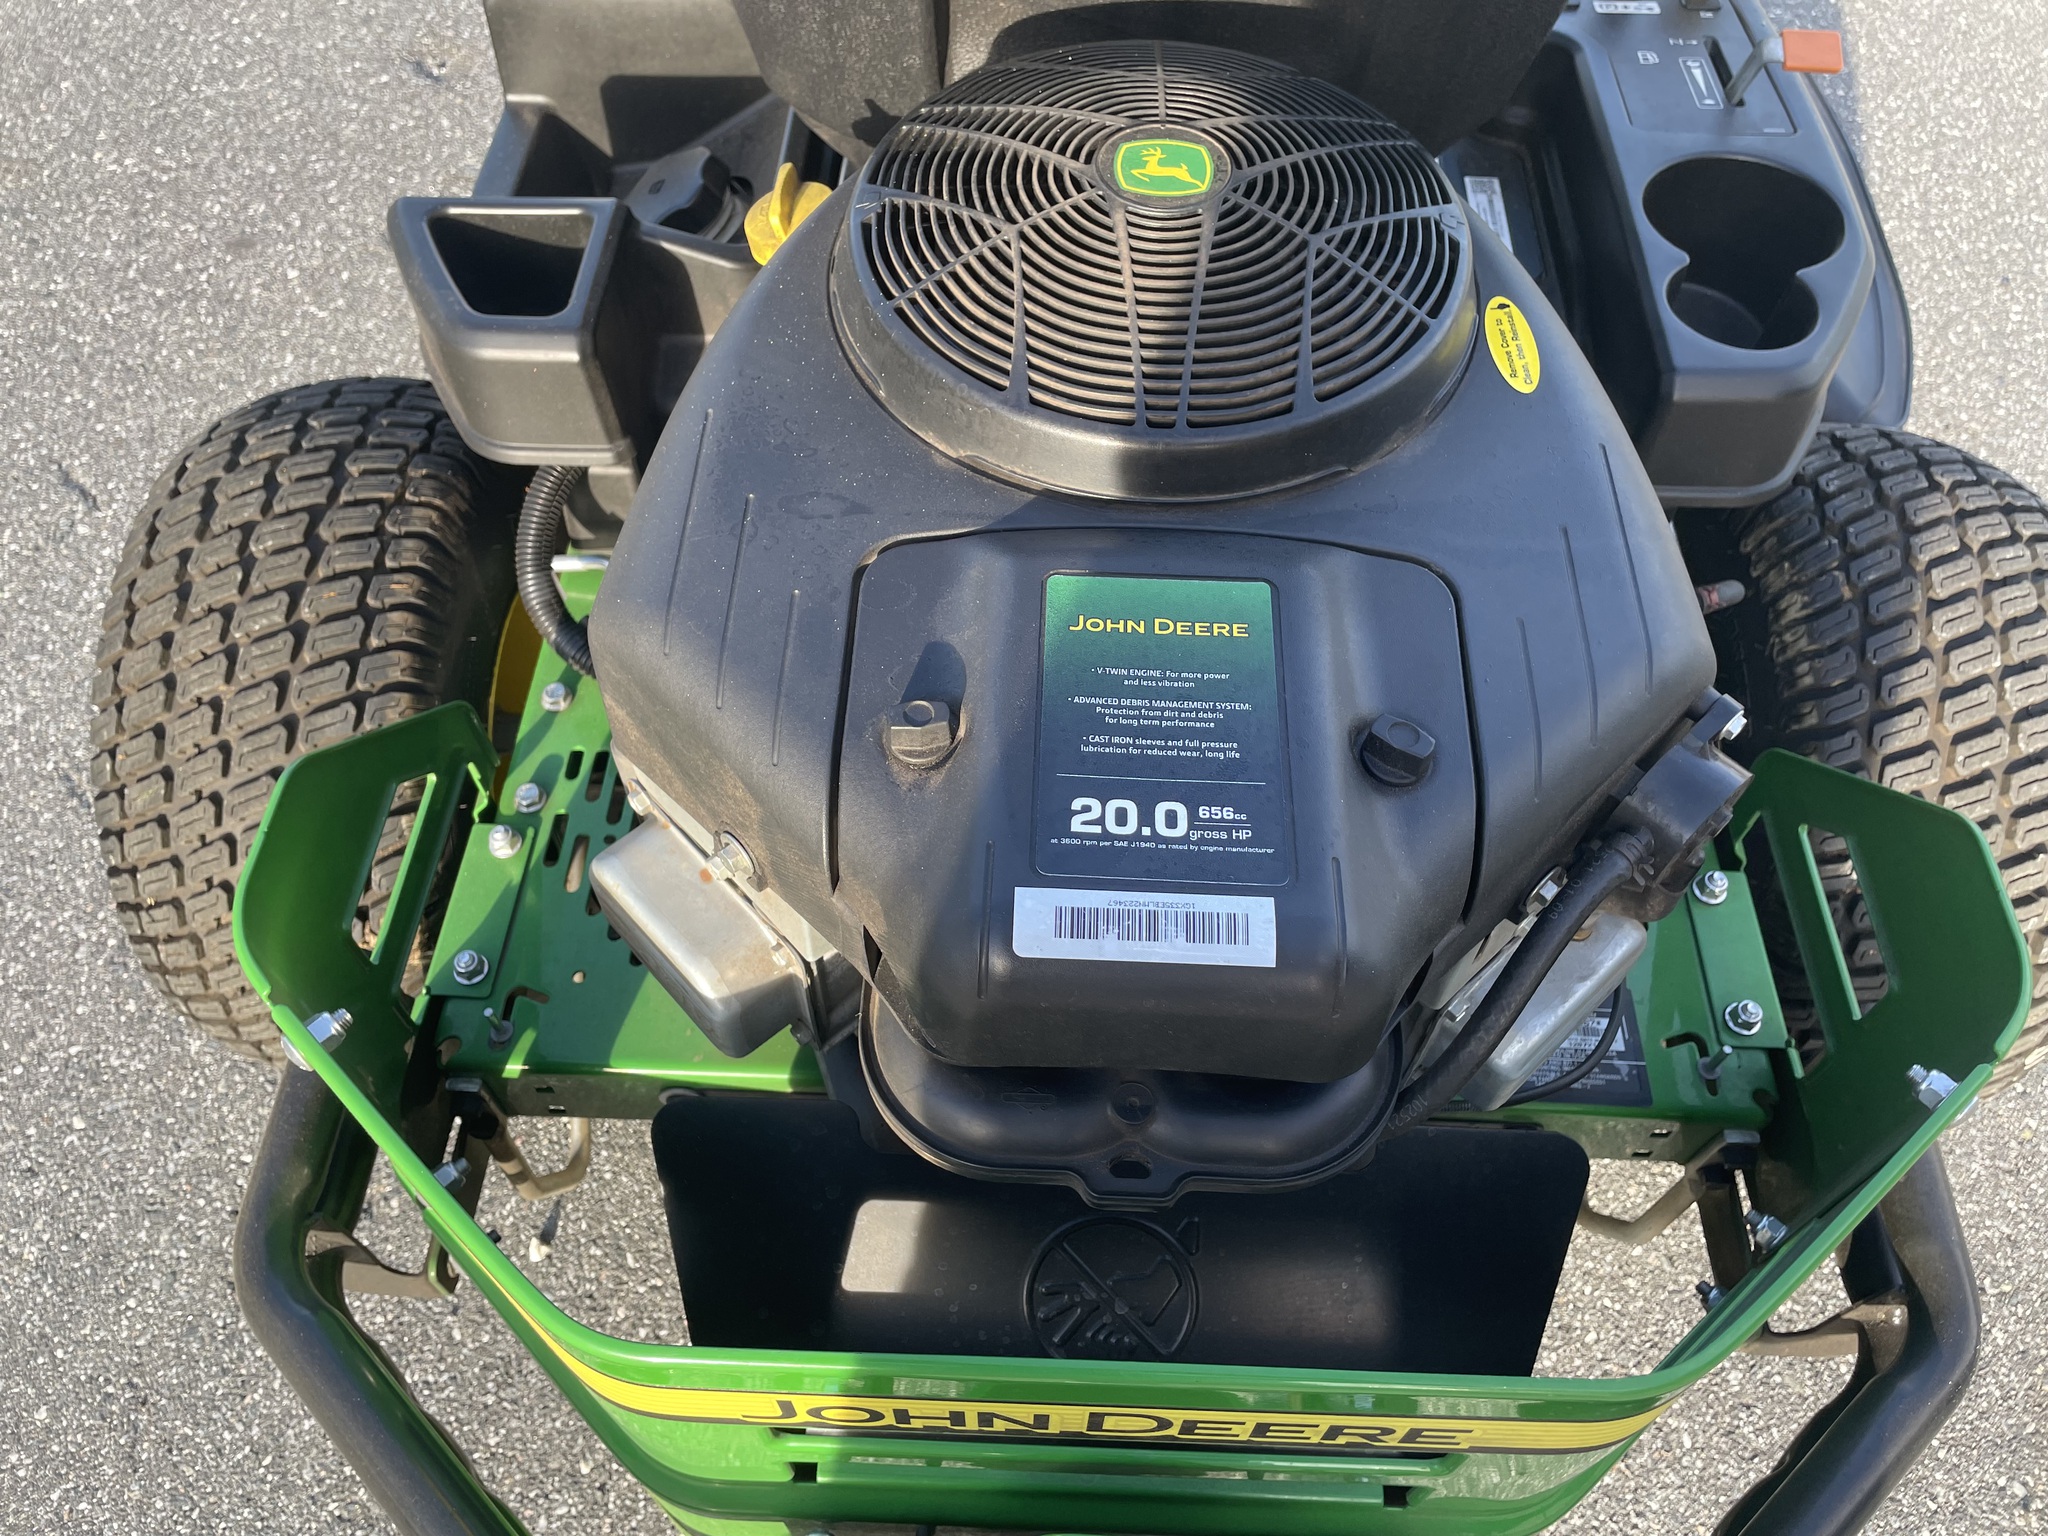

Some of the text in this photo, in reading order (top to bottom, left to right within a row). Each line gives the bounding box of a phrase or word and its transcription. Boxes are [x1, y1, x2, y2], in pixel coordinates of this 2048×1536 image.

[1496, 318, 1518, 378] Remove Cover to
[1516, 343, 1525, 360] then
[1069, 614, 1249, 637] JOHN DEERE
[1096, 667, 1128, 675] V-TWIN
[1129, 669, 1164, 677] ENGINE:
[1140, 679, 1156, 687] less
[1157, 680, 1195, 688] vibration
[1073, 696, 1252, 711] ADVANCED DEBRIS MANAGEMENT SYSTEM:
[1096, 706, 1139, 715] Protection
[1141, 708, 1162, 716] from
[1198, 711, 1224, 719] debris
[1119, 718, 1138, 726] long
[1161, 719, 1215, 728] performance
[1088, 735, 1238, 749] CAST IRON sleeves and full pressure
[1080, 744, 1241, 760] lubrication for reduced wear, long life
[1070, 797, 1188, 837] 20.0
[1189, 829, 1252, 841] gross HP
[1225, 846, 1275, 854] manufacturer
[741, 1400, 1475, 1446] JOHN DEERE
